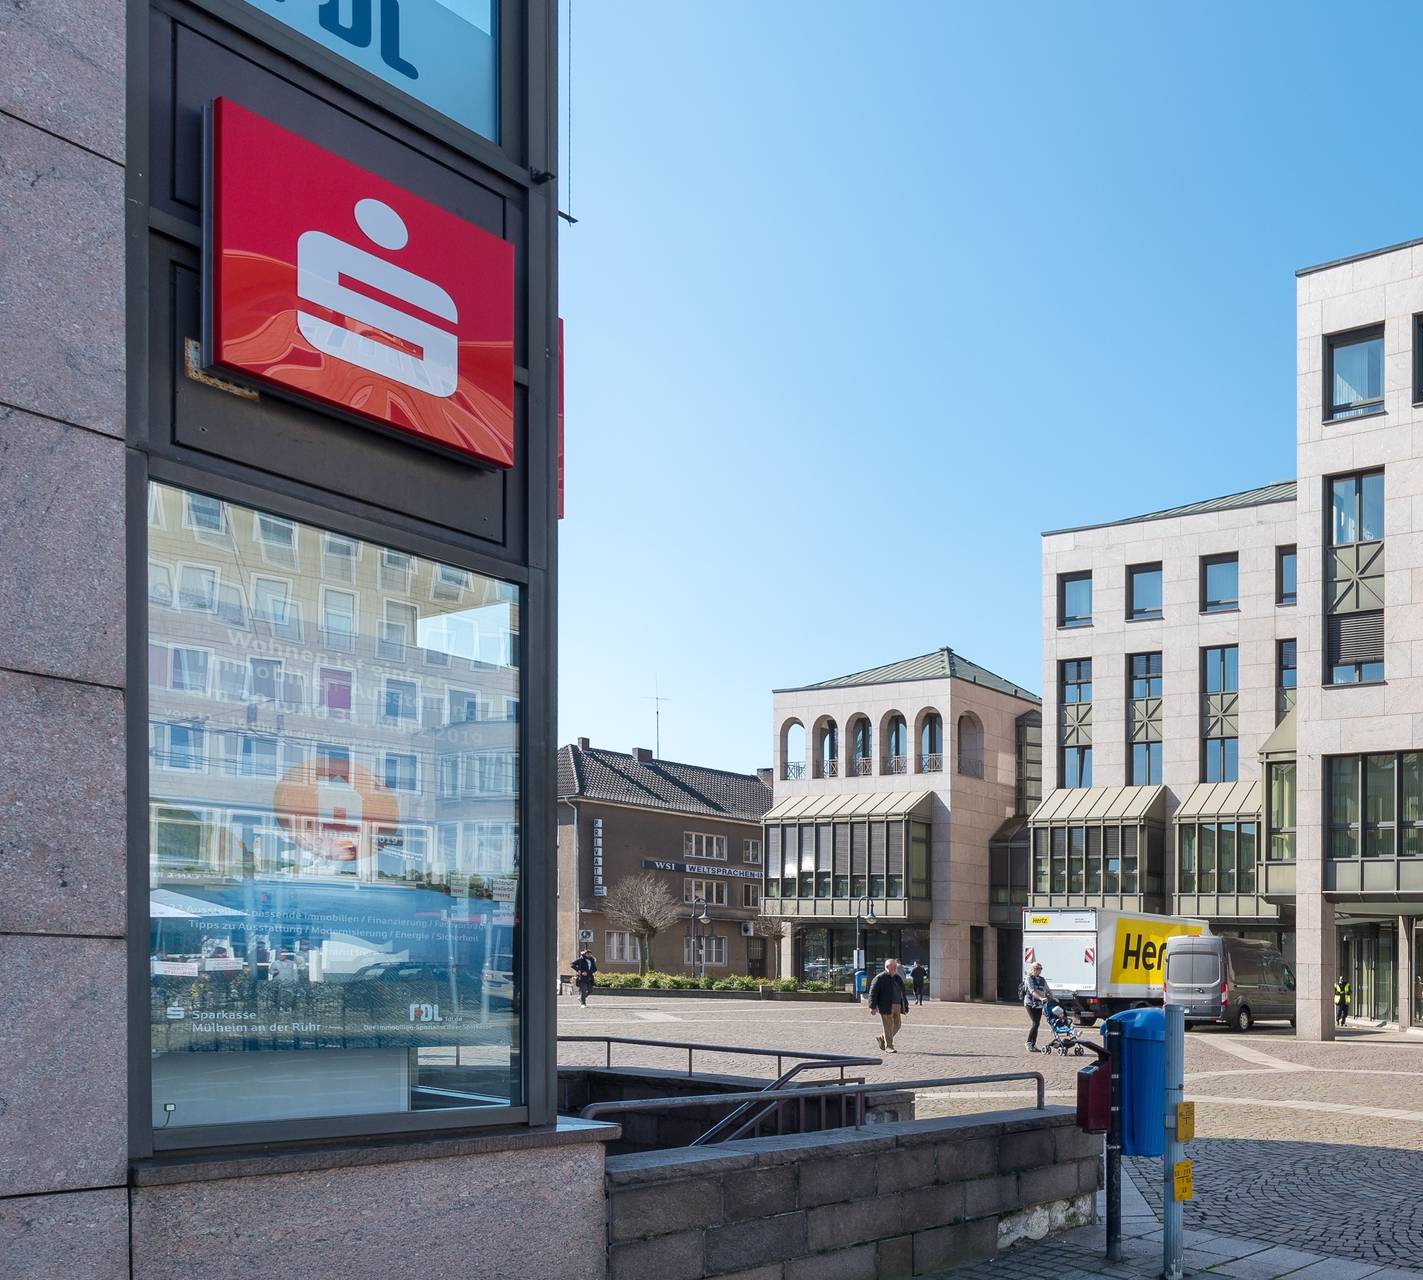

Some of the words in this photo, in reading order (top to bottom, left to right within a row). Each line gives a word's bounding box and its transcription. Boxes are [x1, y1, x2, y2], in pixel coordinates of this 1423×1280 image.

[227, 629, 328, 662] Wohnen
[655, 861, 675, 870] WSI
[367, 914, 428, 928] Finanzierung
[189, 919, 221, 930] Tipps
[238, 923, 303, 935] Ausstattung
[311, 926, 388, 940] Modernisierung
[1122, 933, 1167, 970] Her
[192, 1009, 257, 1022] Sparkasse
[192, 1022, 247, 1032] Mülheim
[251, 1024, 266, 1032] an
[269, 1022, 289, 1032] der
[292, 1022, 321, 1032] Ruhr
